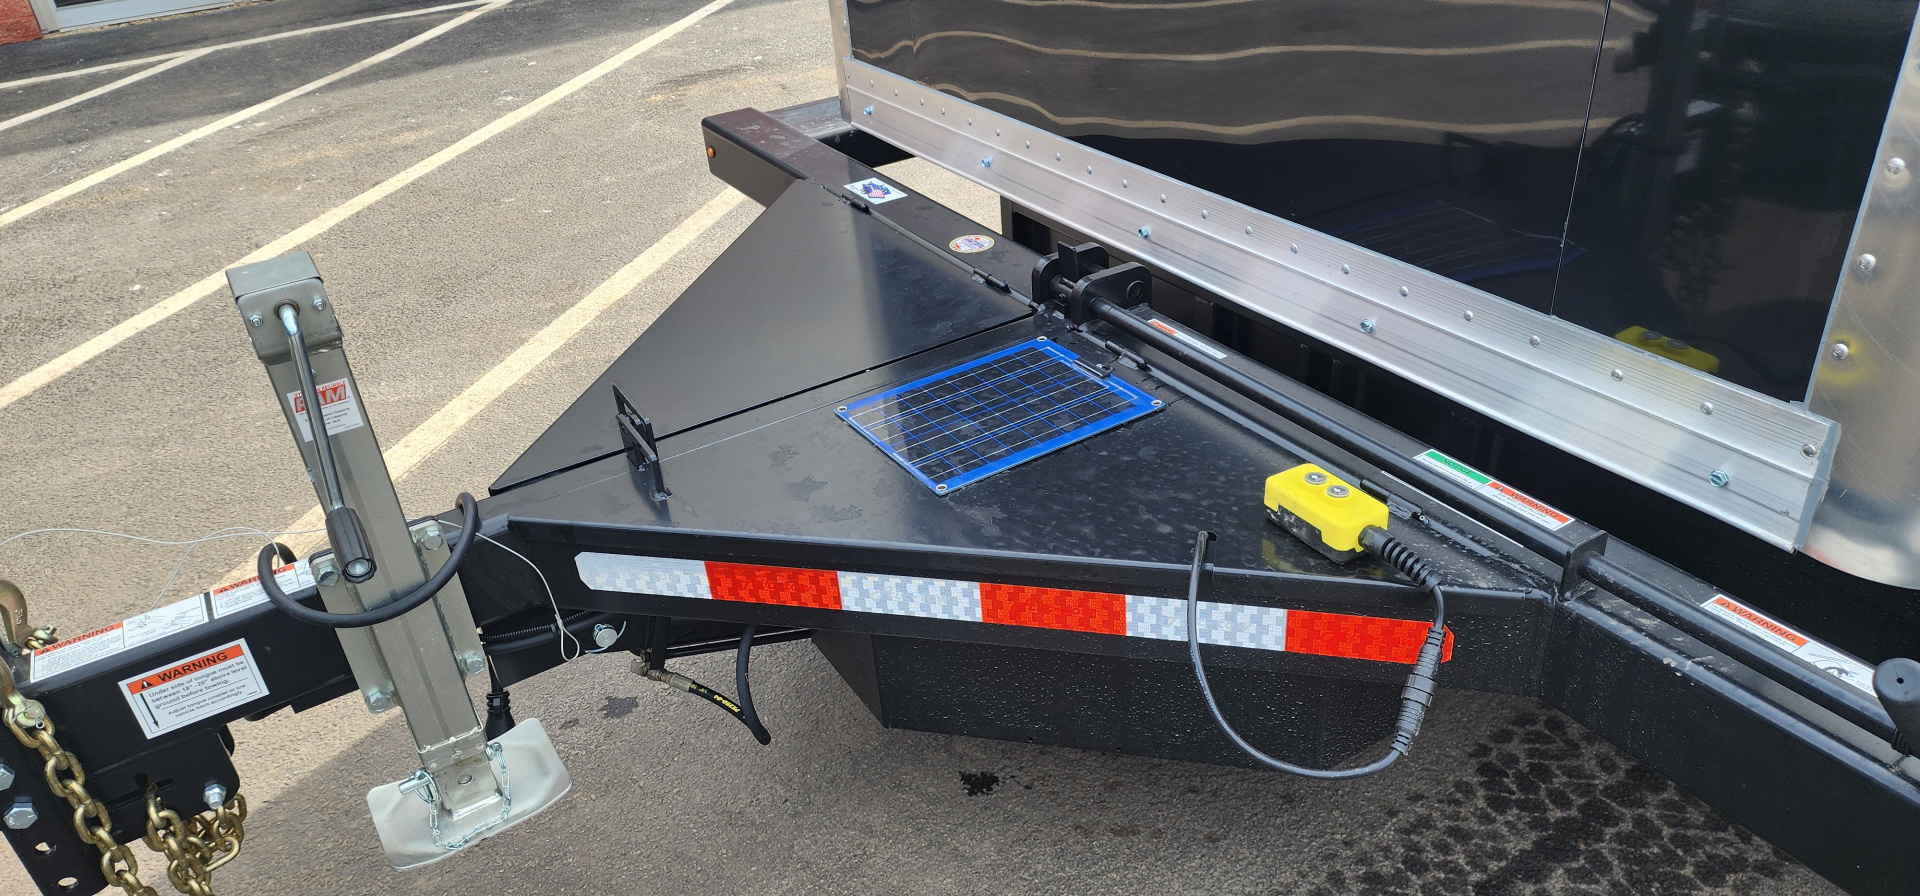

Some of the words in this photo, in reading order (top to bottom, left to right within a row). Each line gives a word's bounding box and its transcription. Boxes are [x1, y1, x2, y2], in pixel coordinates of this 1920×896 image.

[1443, 458, 1473, 476] NOTICE
[1510, 491, 1559, 518] WARNING
[53, 624, 114, 649] WARNING
[1733, 606, 1798, 641] WARNING
[148, 687, 170, 698] Under
[170, 682, 185, 690] side
[194, 670, 218, 681] tongue
[218, 663, 235, 673] must
[158, 652, 228, 682] WARNING
[151, 690, 181, 703] between
[210, 672, 230, 682] above
[231, 665, 247, 674] level
[155, 696, 181, 709] ground
[181, 688, 203, 699] before
[204, 679, 230, 690] towing.
[168, 705, 187, 715] Adjust
[187, 699, 207, 709] tongue
